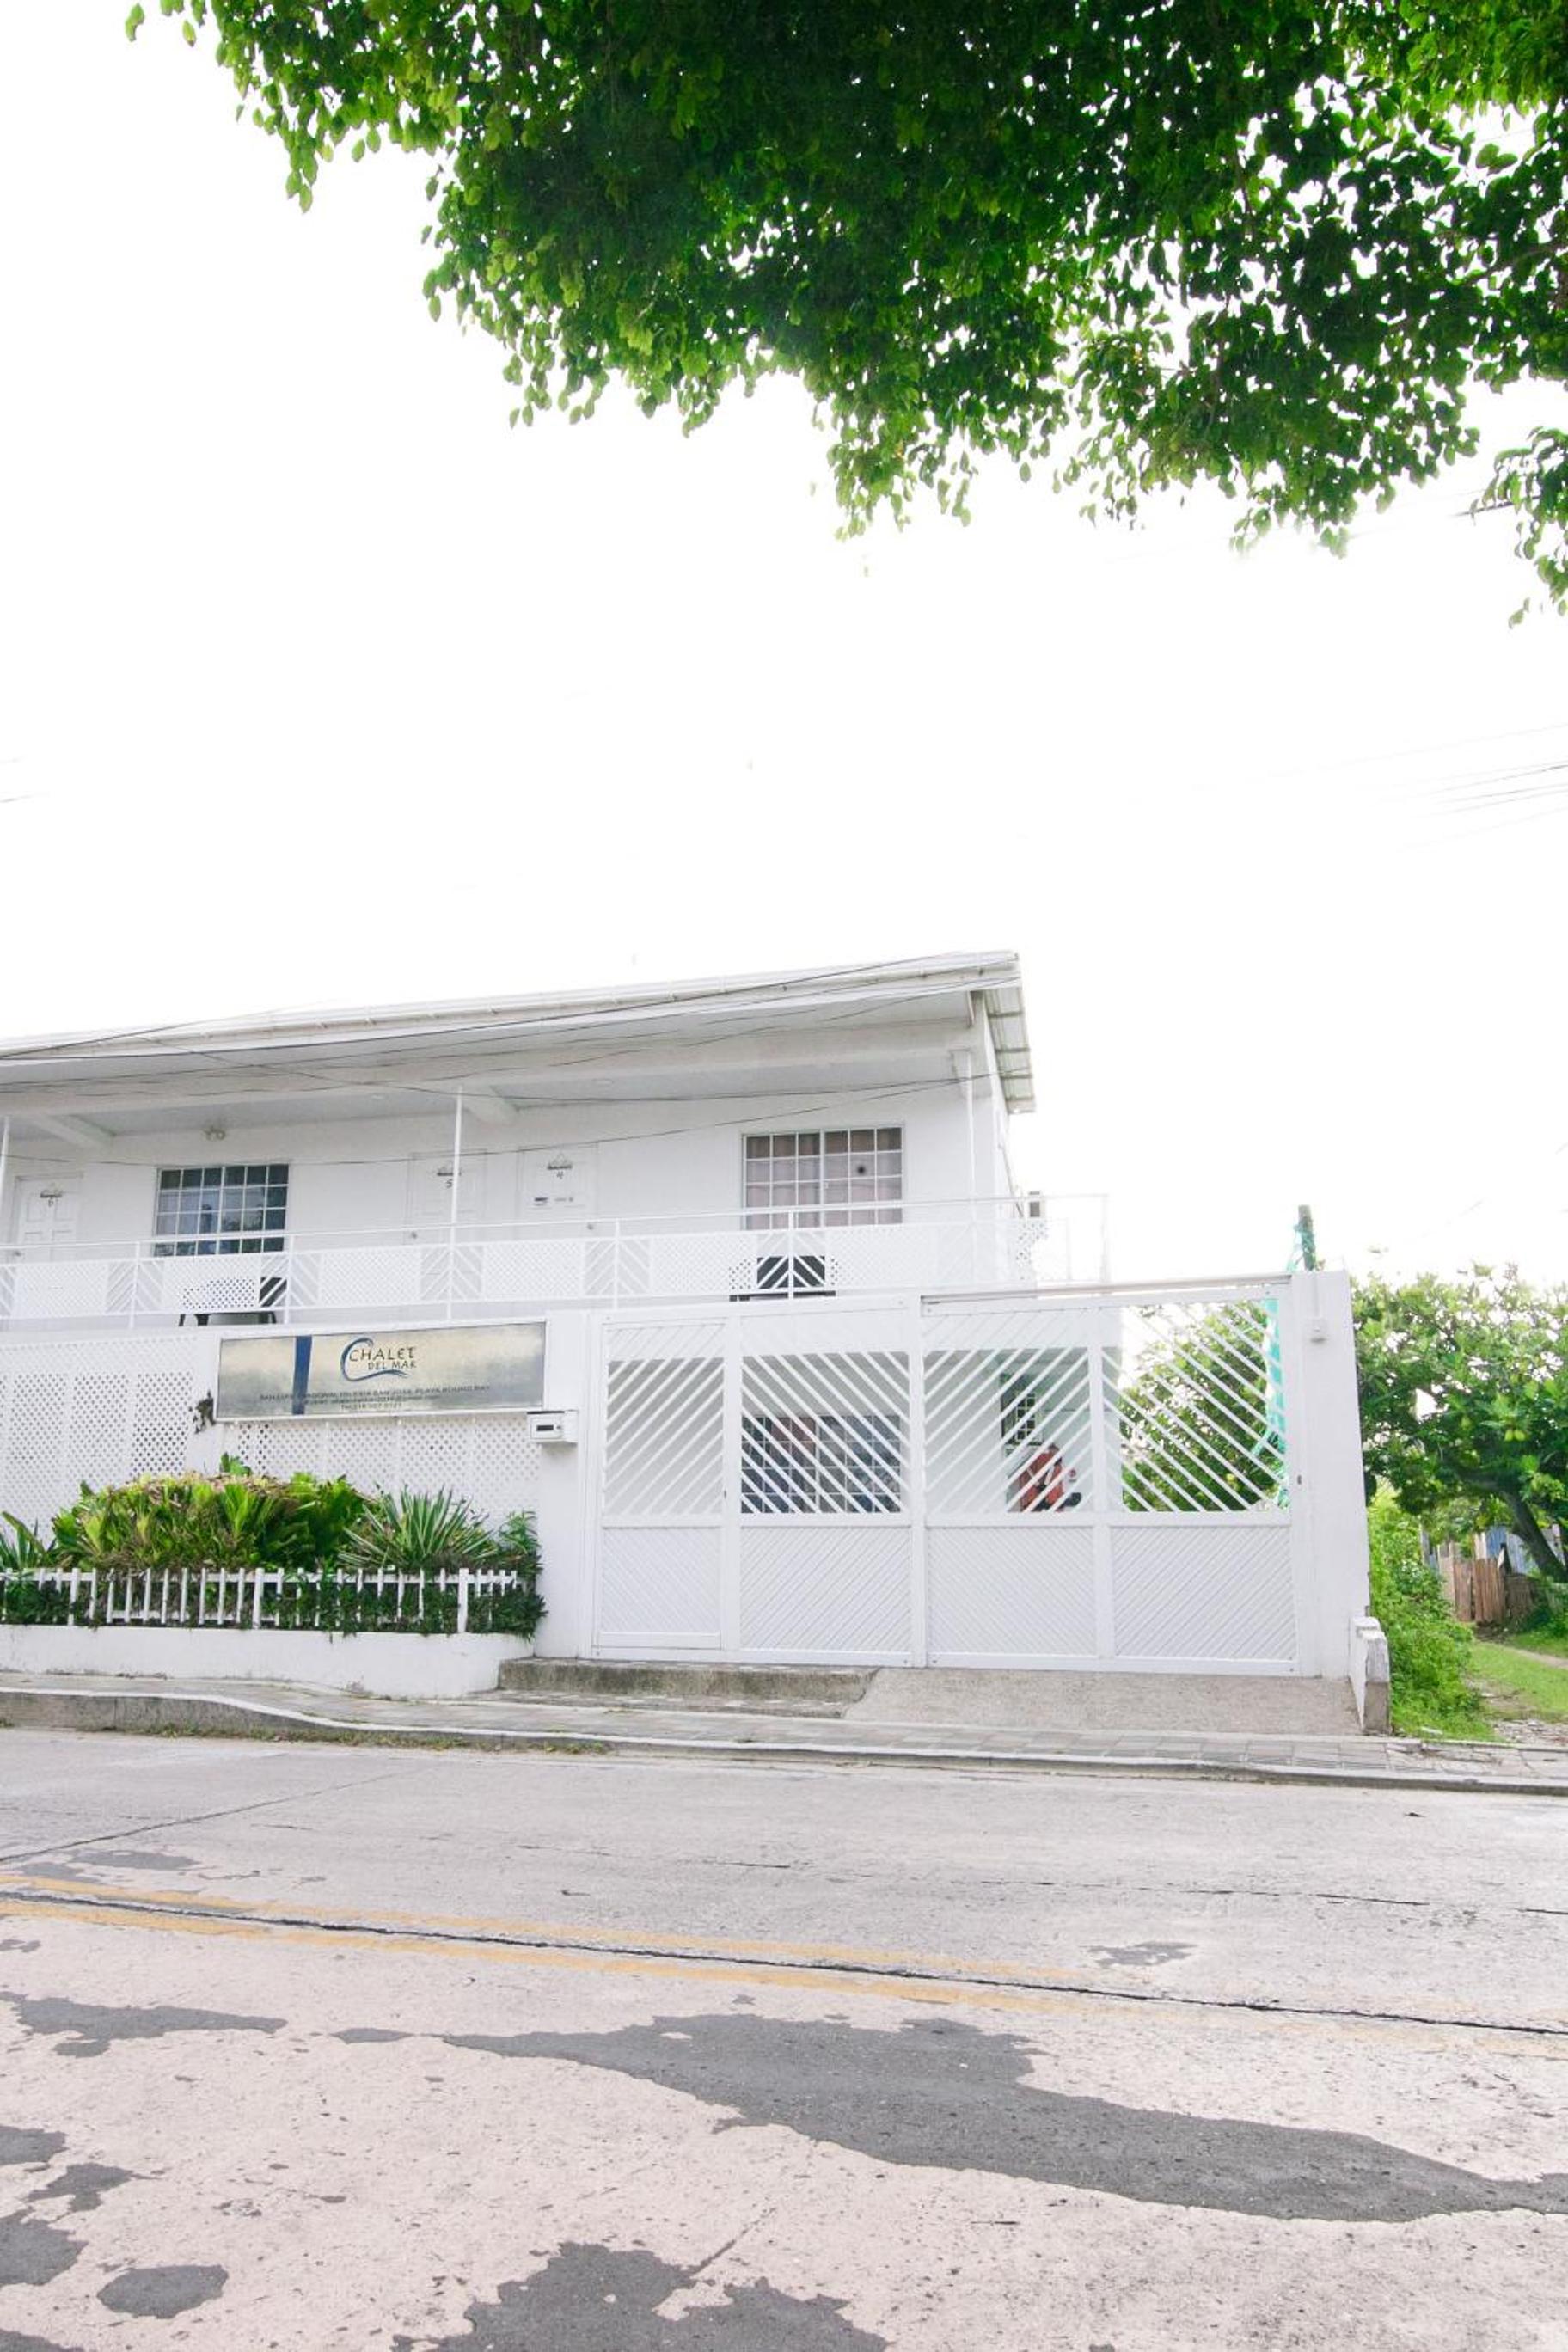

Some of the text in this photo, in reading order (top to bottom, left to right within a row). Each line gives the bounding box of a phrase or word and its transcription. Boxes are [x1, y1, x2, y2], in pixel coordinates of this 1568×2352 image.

[349, 1346, 416, 1362] CHALET
[368, 1359, 416, 1370] DEL MAR
